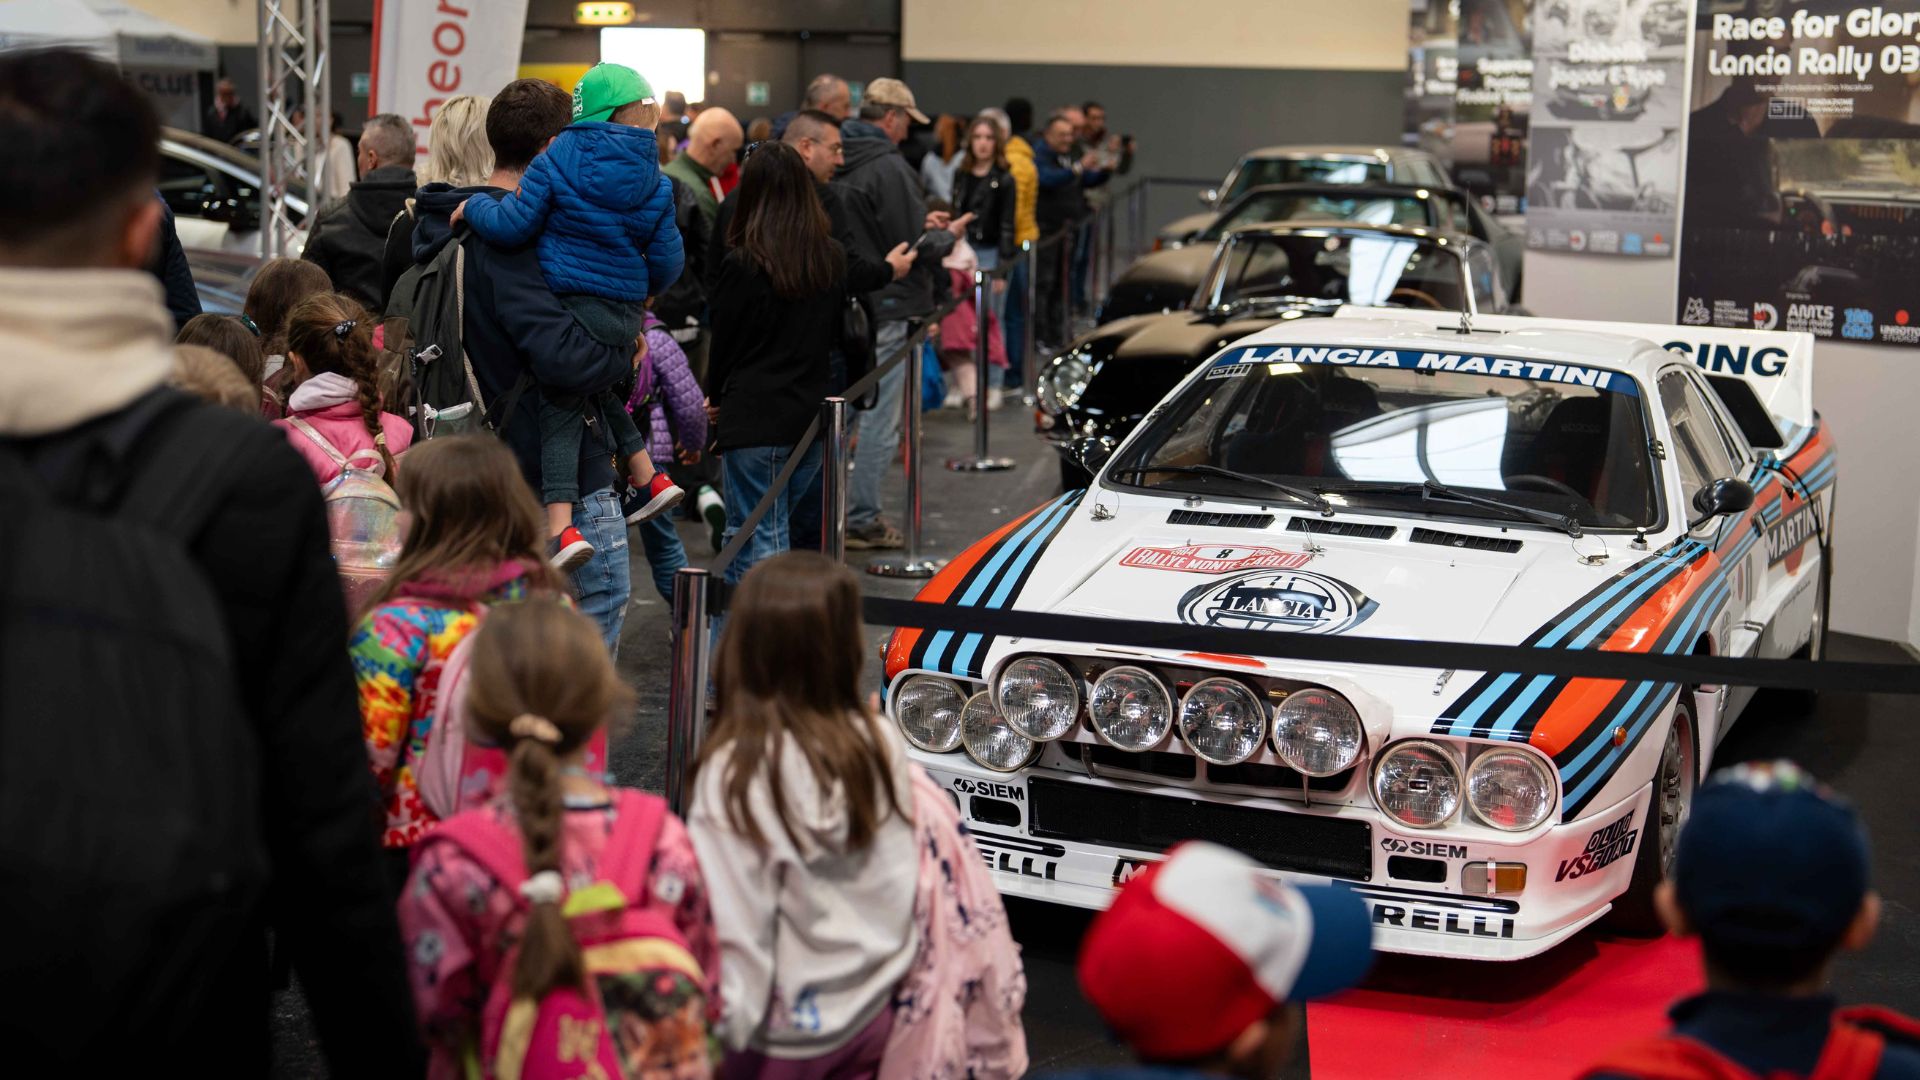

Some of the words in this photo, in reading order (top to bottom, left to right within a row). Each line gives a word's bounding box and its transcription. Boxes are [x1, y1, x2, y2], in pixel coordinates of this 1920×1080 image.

[1712, 13, 1786, 41] Race
[1791, 9, 1840, 39] for
[412, 0, 469, 155] heor
[1708, 46, 1791, 76] Lancia
[1798, 45, 1873, 81] Rally
[1879, 44, 1920, 75] 03
[1238, 346, 1401, 367] LANCIA
[1415, 354, 1613, 389] MARTINI
[1766, 499, 1824, 561] MARTINI
[1134, 549, 1188, 568] RALLYE
[1215, 549, 1234, 558] 8
[1227, 596, 1317, 619] LANCIA
[977, 780, 1025, 800] SIEM
[1588, 815, 1632, 850] OLIO
[1409, 840, 1468, 860] SIEM
[1371, 903, 1515, 939] RELLI
